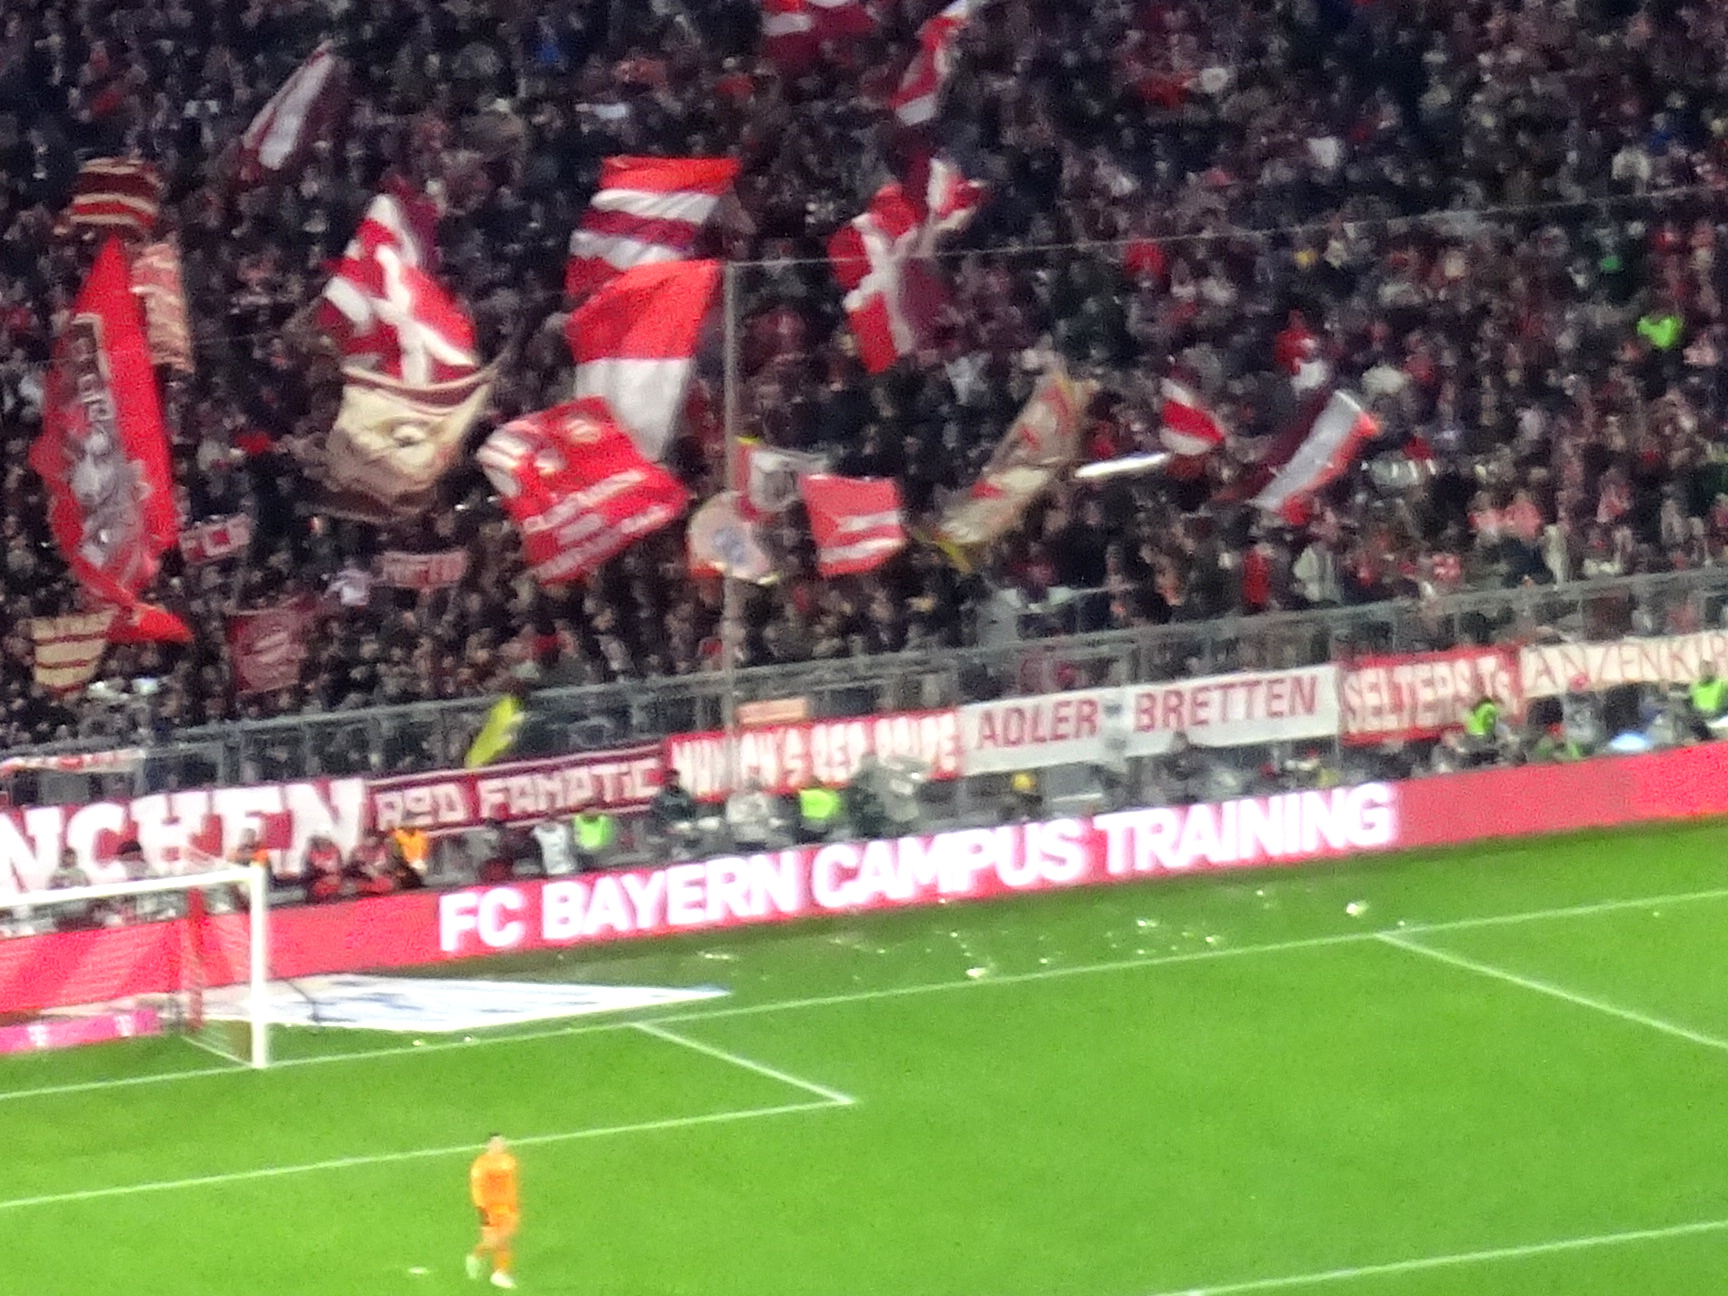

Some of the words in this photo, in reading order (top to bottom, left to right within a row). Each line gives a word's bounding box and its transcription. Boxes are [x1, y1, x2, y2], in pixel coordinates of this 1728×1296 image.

[977, 698, 1099, 749] ADLER
[1132, 675, 1318, 734] BRETTEN
[439, 886, 526, 953] FC
[541, 850, 798, 942] BAYERN
[811, 817, 1083, 908] CAMPUS
[1094, 781, 1392, 876] TRAINING
